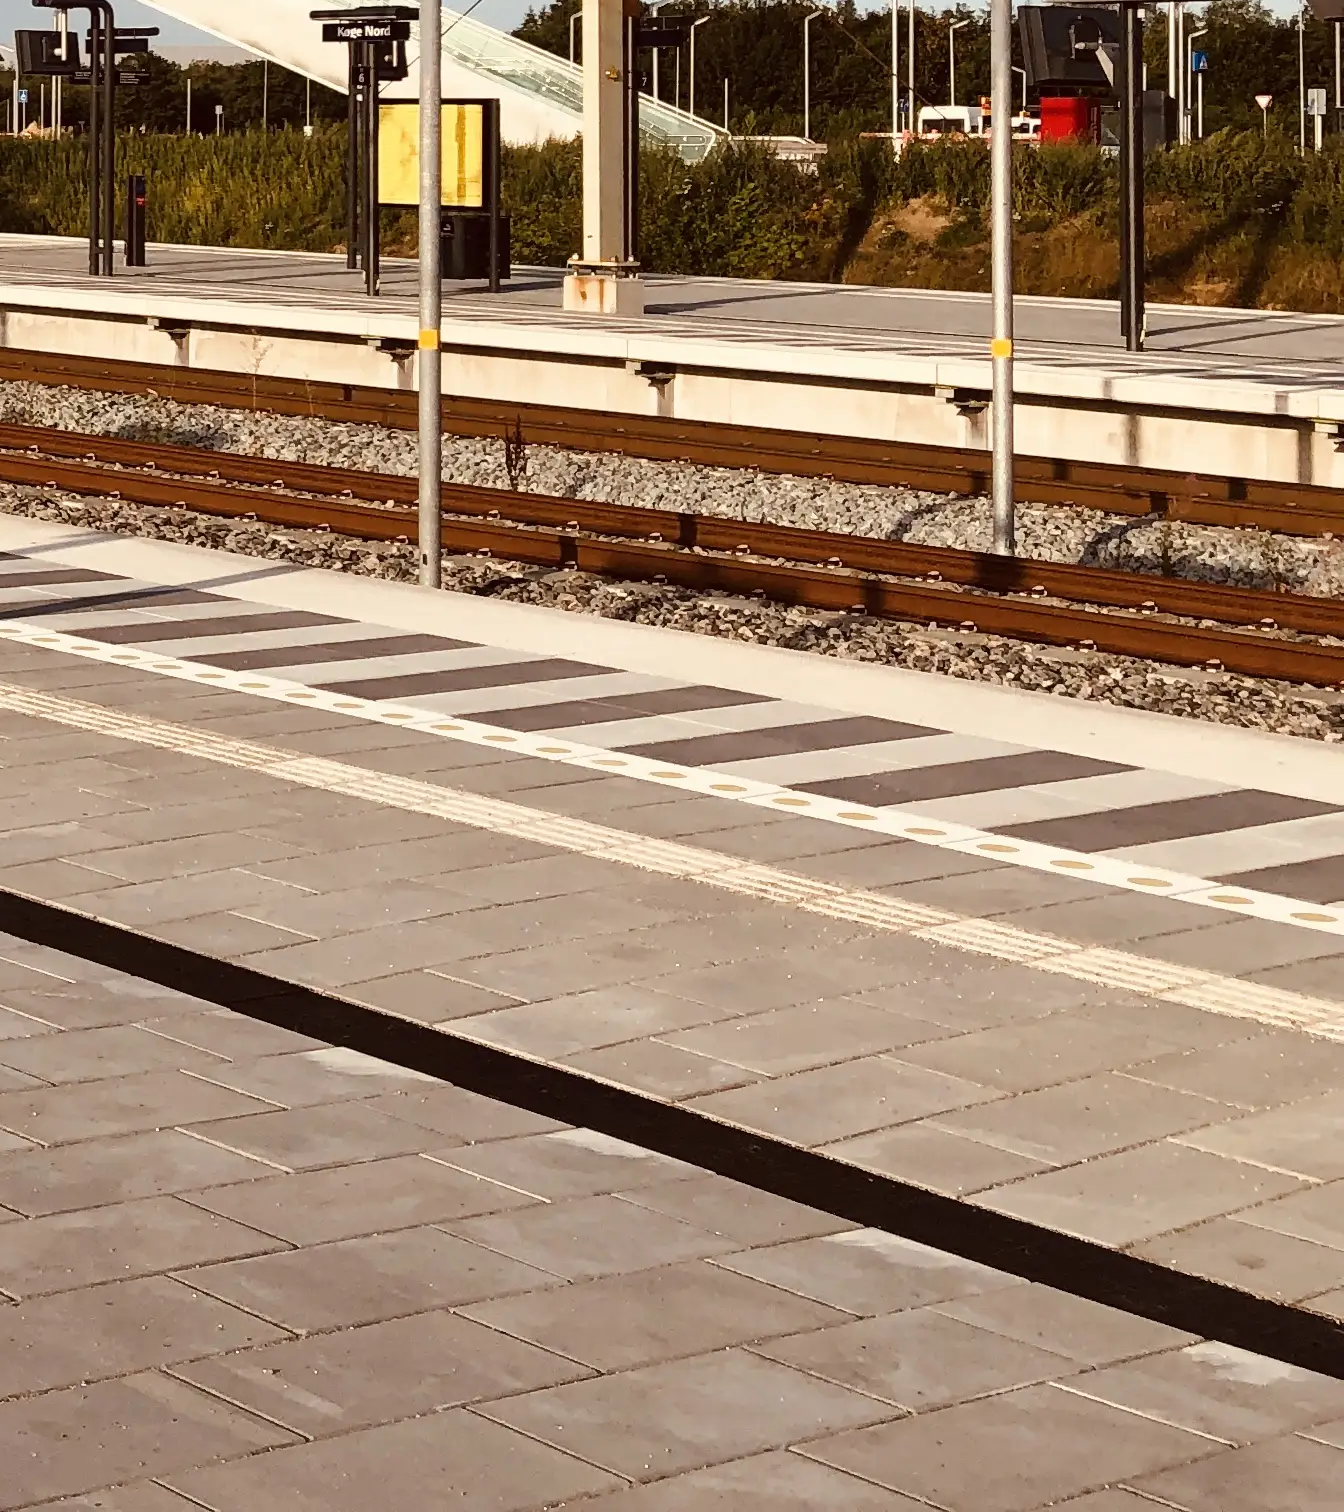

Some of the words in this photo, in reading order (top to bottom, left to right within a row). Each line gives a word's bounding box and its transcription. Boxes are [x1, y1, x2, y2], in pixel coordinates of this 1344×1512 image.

[337, 27, 363, 39] Køge
[364, 25, 391, 37] Nord
[358, 73, 365, 83] 6
